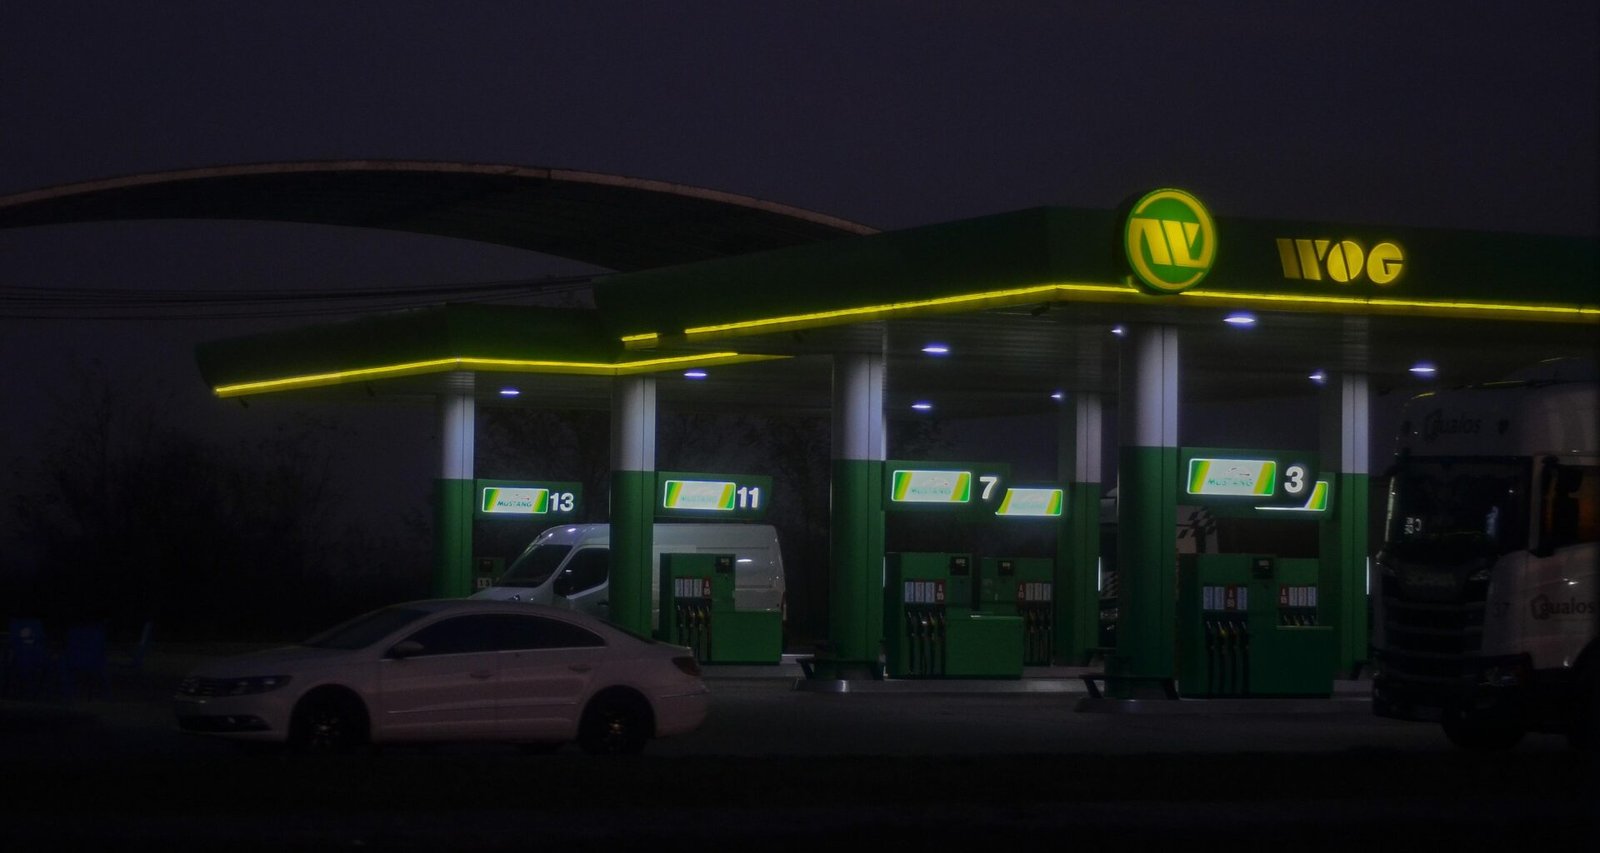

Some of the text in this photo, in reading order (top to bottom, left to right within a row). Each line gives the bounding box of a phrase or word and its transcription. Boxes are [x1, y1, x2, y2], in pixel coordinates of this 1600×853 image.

[1276, 238, 1404, 284] WOG
[979, 476, 998, 500] 7
[1284, 465, 1304, 494] 3
[550, 492, 574, 512] 13
[737, 486, 759, 508] 11
